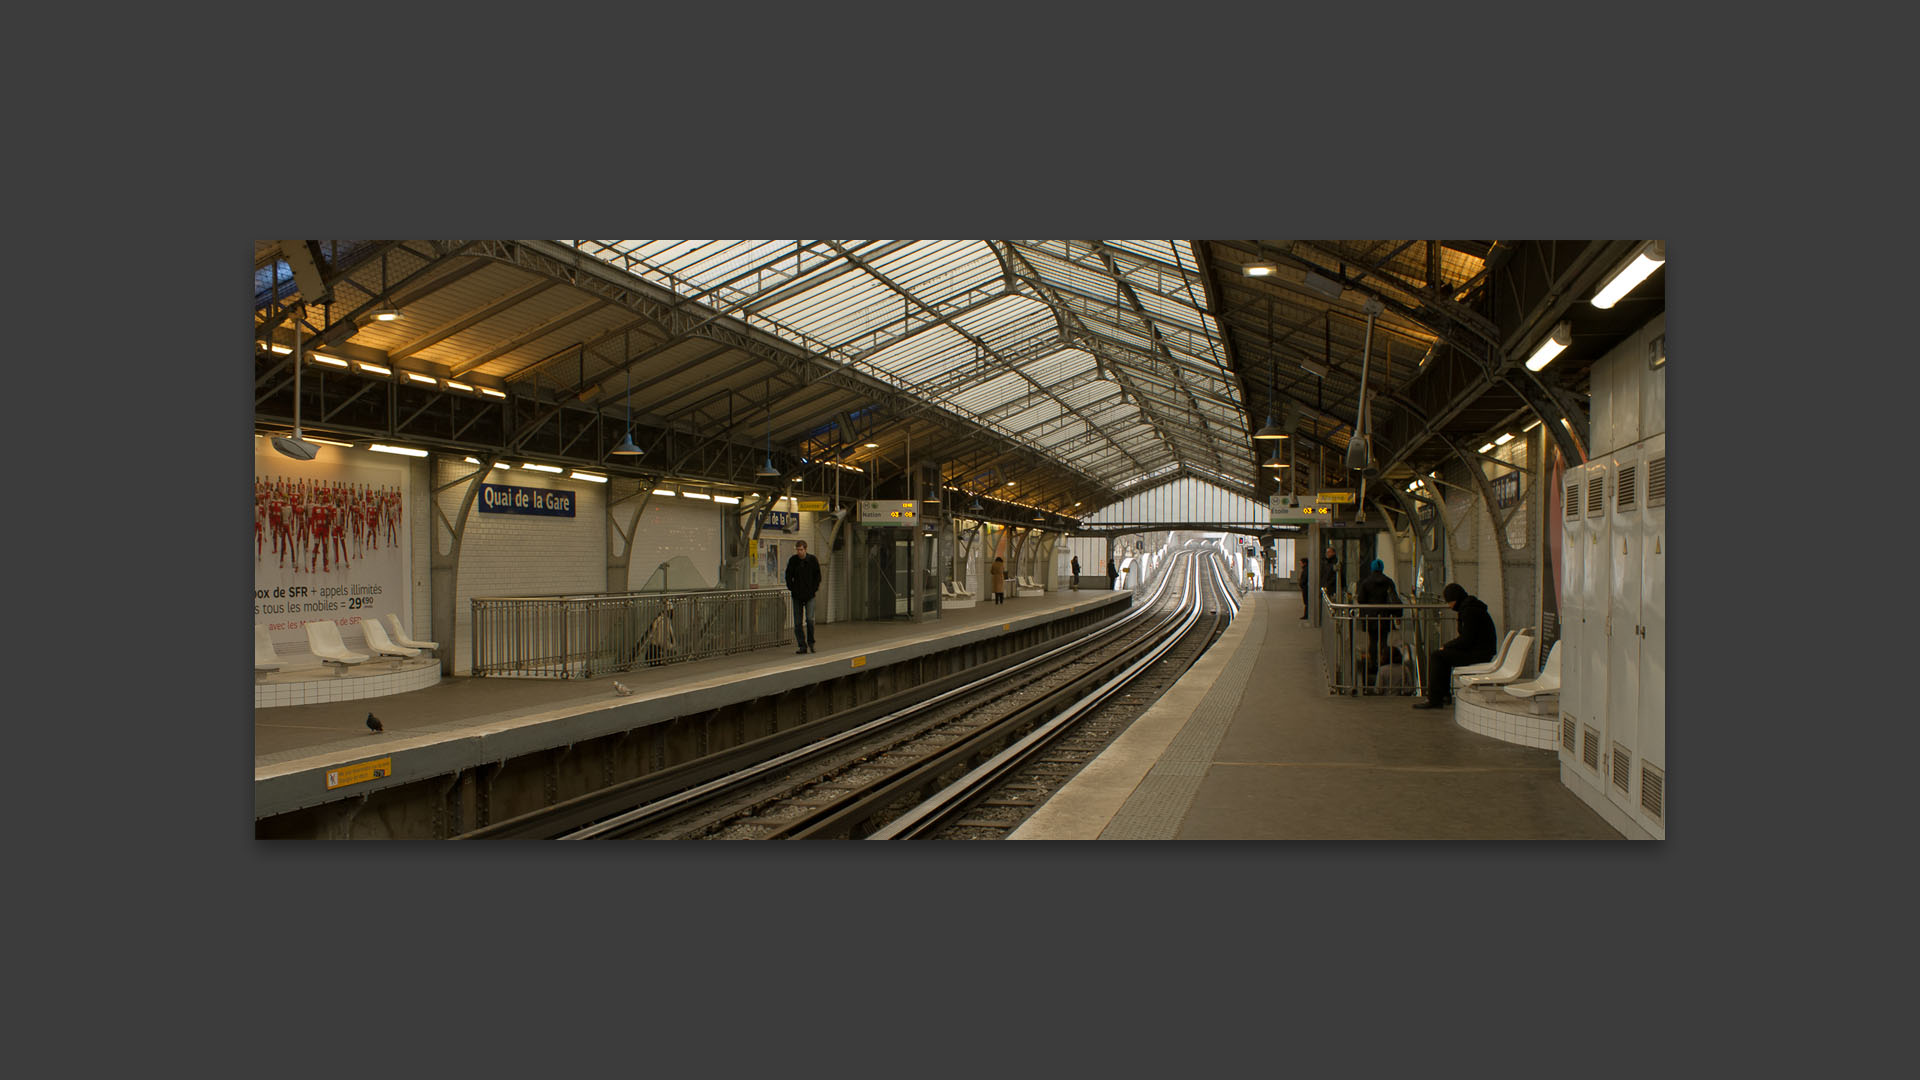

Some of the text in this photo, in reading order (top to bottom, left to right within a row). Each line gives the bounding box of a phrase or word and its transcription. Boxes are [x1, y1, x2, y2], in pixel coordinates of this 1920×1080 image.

[484, 487, 569, 511] Quai de la Gare
[772, 513, 779, 525] de
[255, 589, 270, 598] ox
[273, 586, 285, 598] de
[289, 586, 308, 597] SFR
[320, 584, 348, 599] appels
[351, 584, 382, 595] illimités
[263, 604, 285, 614] tous
[288, 602, 300, 613] les
[304, 600, 338, 611] mobiles
[269, 623, 285, 631] avec
[288, 620, 298, 630] les
